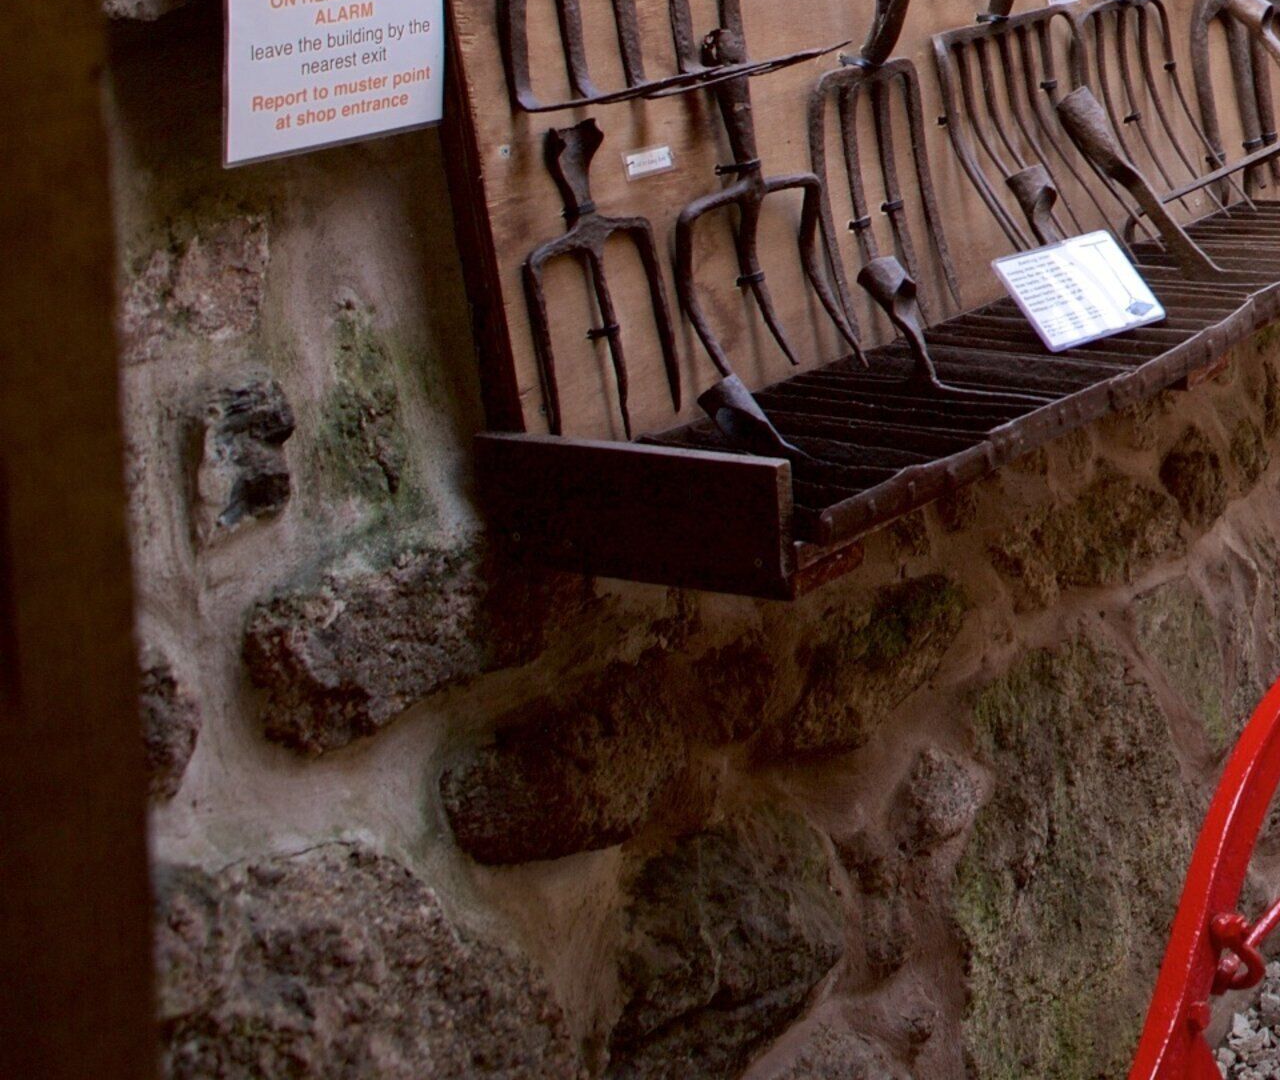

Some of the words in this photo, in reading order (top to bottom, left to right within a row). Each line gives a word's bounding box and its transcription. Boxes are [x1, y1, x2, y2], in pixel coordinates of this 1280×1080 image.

[315, 3, 374, 25] ALARM
[250, 42, 293, 61] leave
[298, 37, 322, 53] the
[327, 27, 383, 50] building
[388, 23, 405, 42] by
[408, 19, 431, 35] the
[301, 53, 357, 76] nearest
[361, 48, 387, 65] exit
[252, 90, 308, 114] Report
[313, 85, 329, 100] to
[333, 75, 388, 98] muster
[392, 66, 432, 90] point
[275, 114, 291, 131] at
[296, 105, 337, 128] shop
[341, 93, 409, 117] entrance
